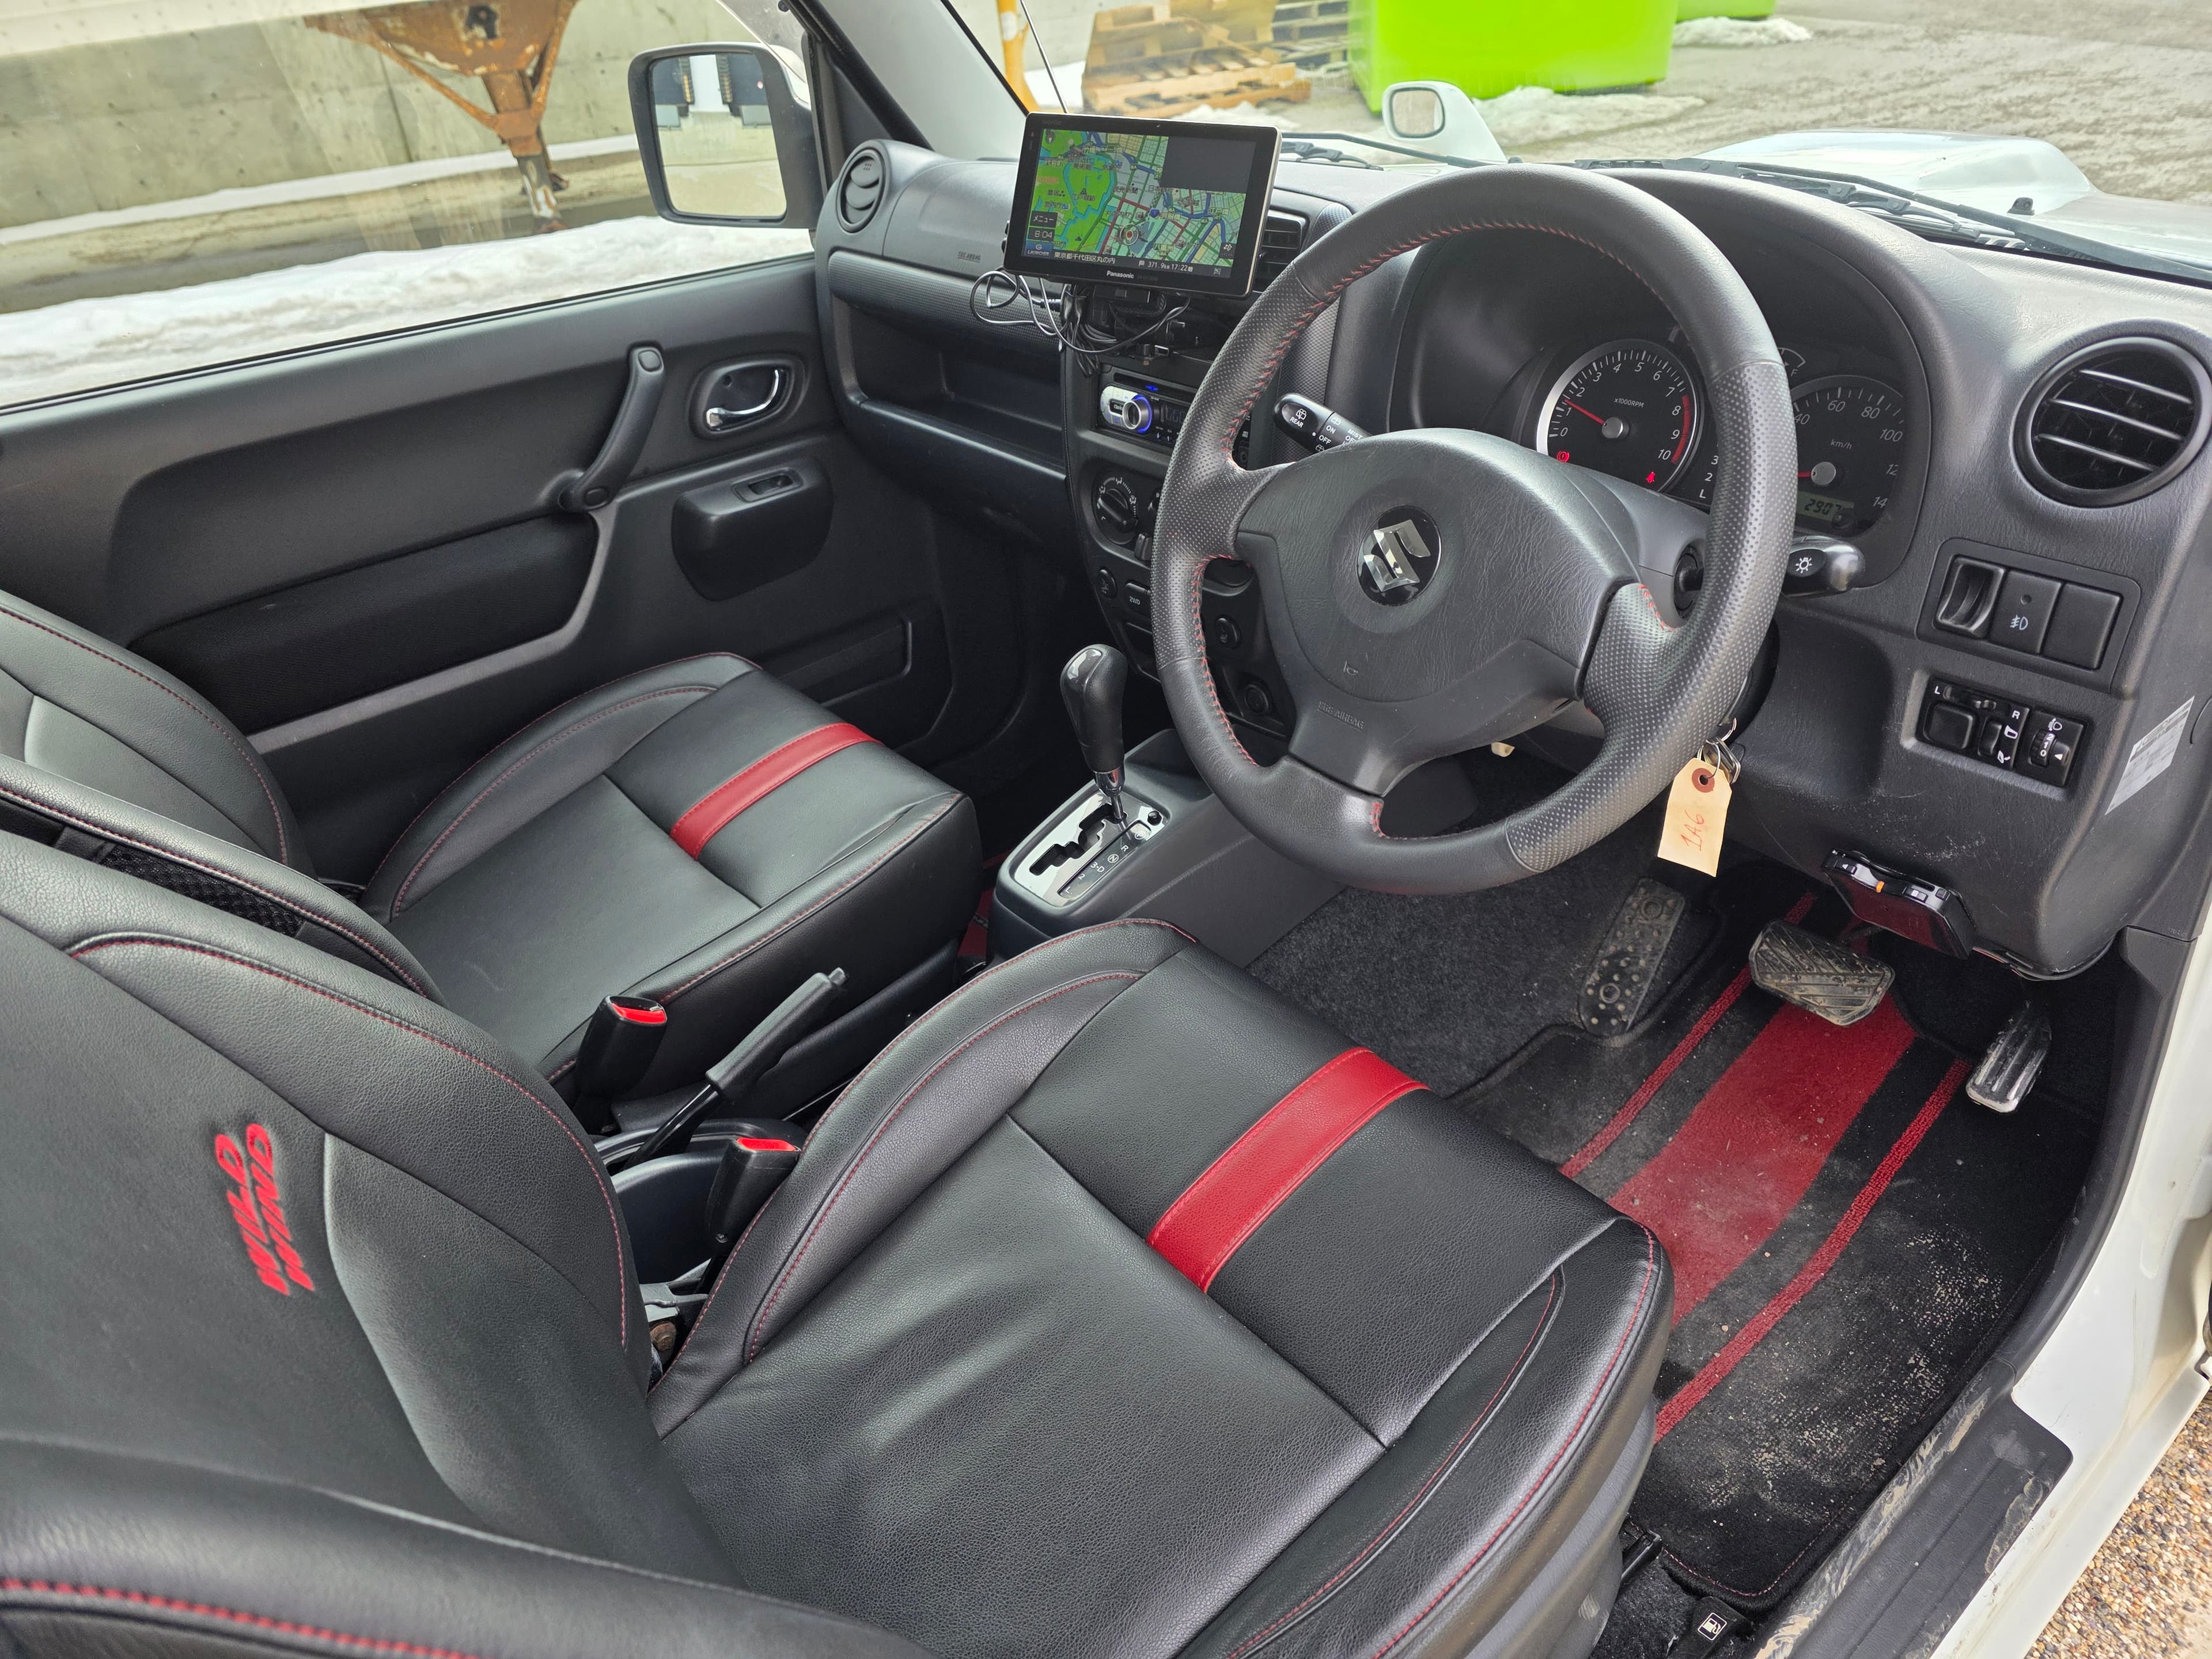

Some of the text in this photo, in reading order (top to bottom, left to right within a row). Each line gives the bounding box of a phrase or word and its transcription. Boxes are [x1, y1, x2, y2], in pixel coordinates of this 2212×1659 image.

[1033, 215, 1054, 225] メニュー
[1034, 230, 1053, 238] 8:04
[1054, 251, 1116, 264] 東京都千代田区丸の内
[1107, 270, 1135, 279] Panasonic
[1613, 363, 1622, 373] 4
[1635, 362, 1645, 372] 5
[1593, 372, 1602, 382] 3
[1653, 370, 1661, 381] 6
[1575, 387, 1585, 397] 2
[1665, 387, 1675, 397] 7
[1672, 405, 1681, 416] 8
[1827, 400, 1846, 412] 60
[1565, 407, 1572, 416] 1
[1861, 406, 1880, 419] 80
[1290, 416, 1304, 429] REAR
[1794, 414, 1810, 425] 40
[1325, 425, 1336, 434] ON
[1347, 429, 1363, 440] MIST
[1560, 427, 1569, 437] 0
[1671, 429, 1680, 440] 9
[1318, 434, 1332, 445] OFF
[1879, 428, 1903, 442] 100
[1830, 438, 1853, 450] km/h
[1658, 449, 1671, 460] 10
[1710, 455, 1719, 465] 3
[1885, 463, 1899, 476] 12
[1705, 472, 1713, 482] 2
[1699, 488, 1706, 499] L
[1872, 496, 1888, 509] 14
[1129, 595, 1141, 605] 2WD
[1934, 685, 1941, 695] L
[2012, 710, 2021, 719] R
[2046, 733, 2054, 741] 2
[2043, 741, 2050, 749] 1
